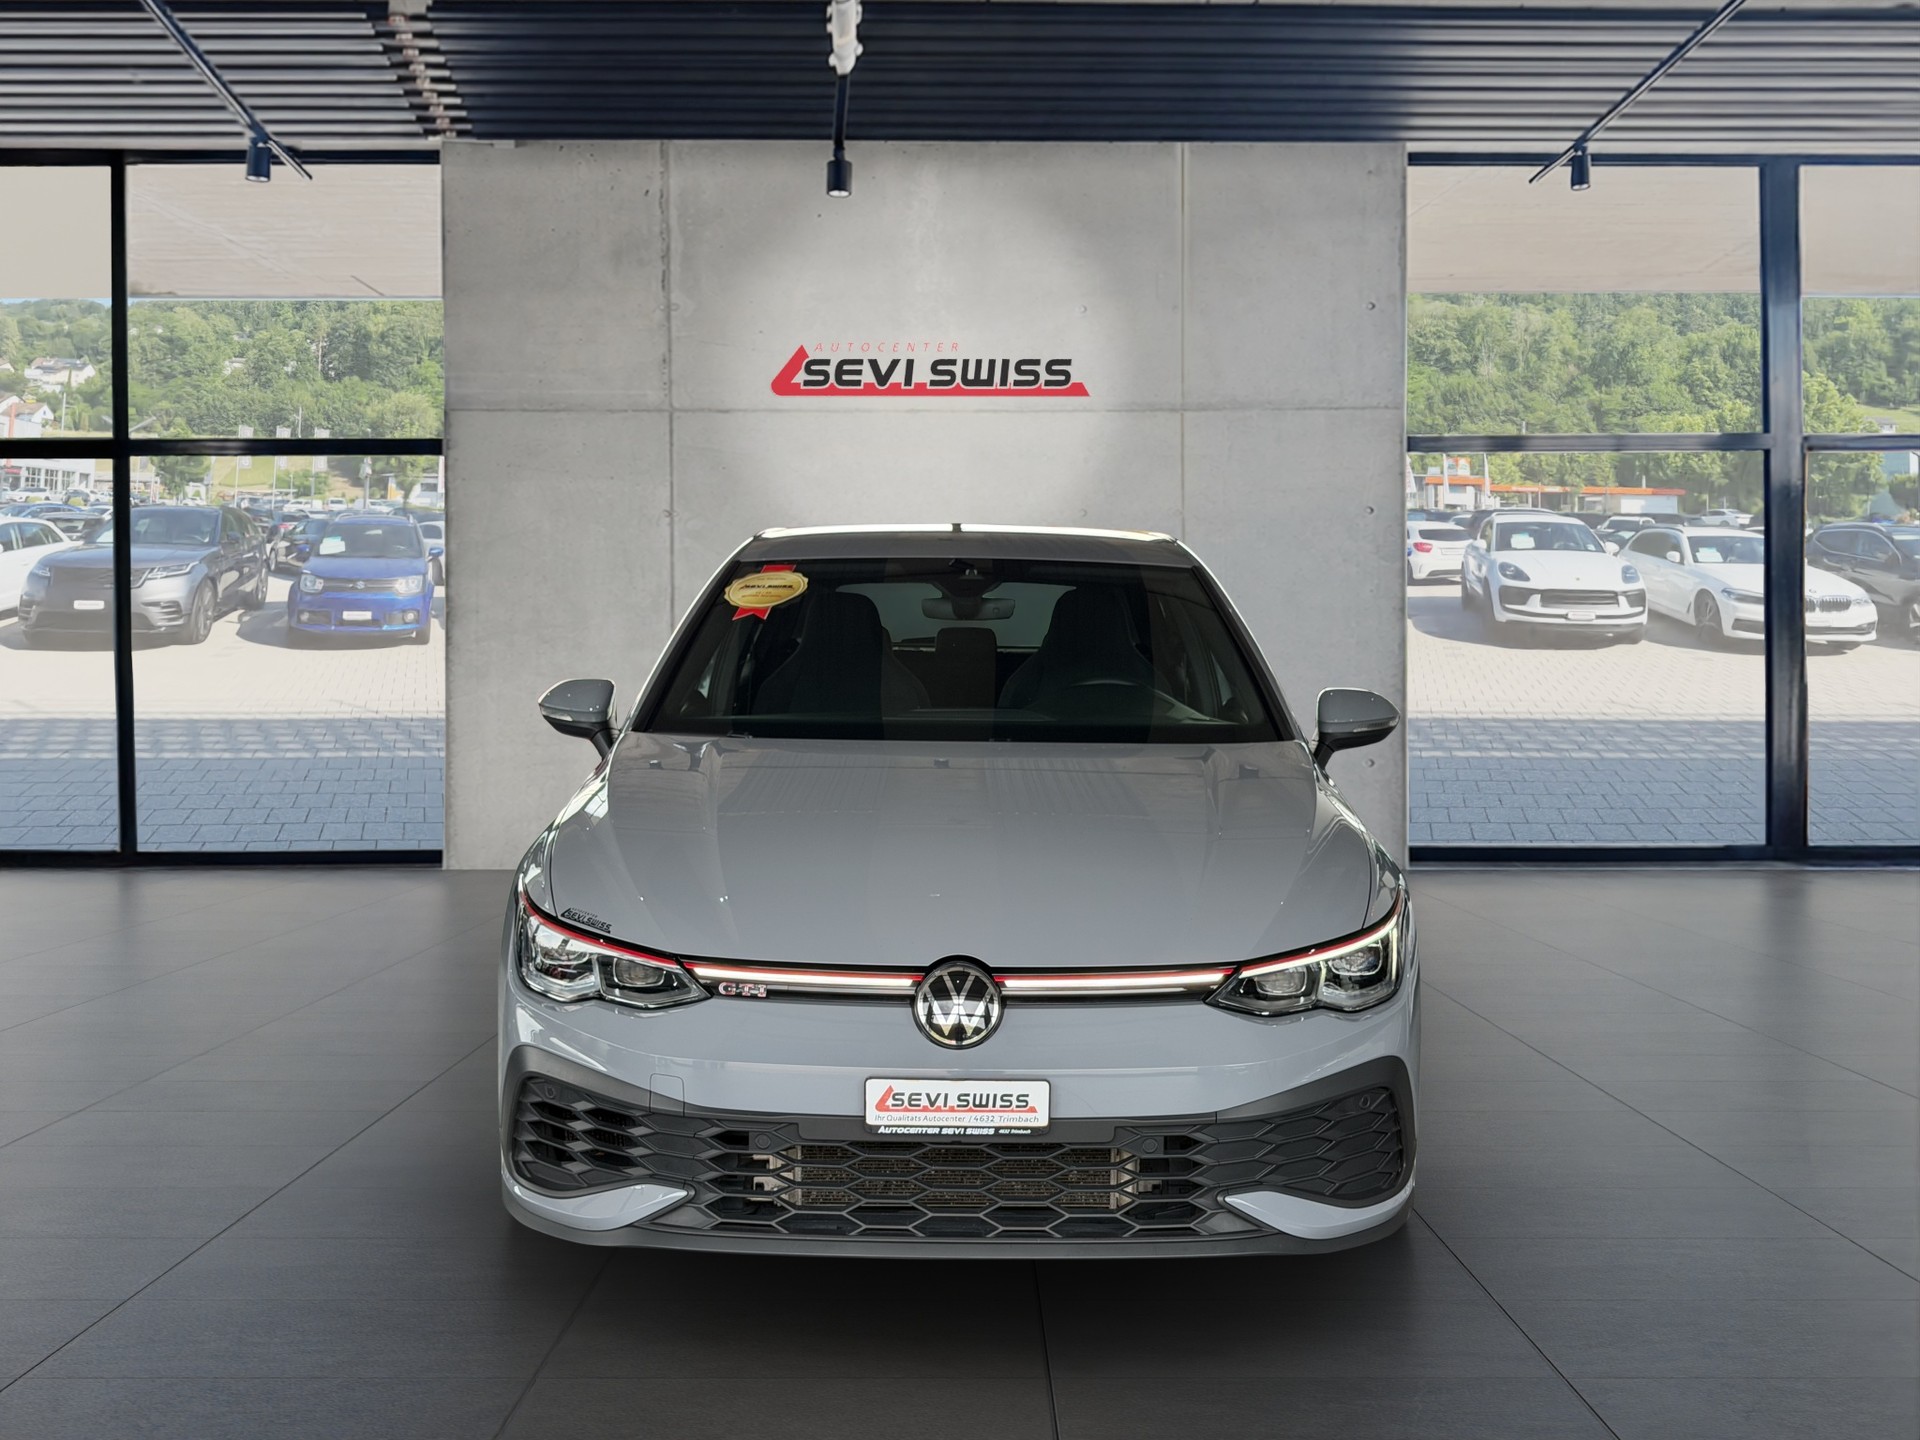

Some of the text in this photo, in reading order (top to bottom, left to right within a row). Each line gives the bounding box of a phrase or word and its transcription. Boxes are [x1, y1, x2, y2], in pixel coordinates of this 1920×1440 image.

[813, 342, 960, 353] AUTOCENTER
[802, 358, 1073, 388] SEVI SWISS
[564, 910, 613, 931] SEVI SWISS
[718, 981, 768, 998] GTI
[891, 1092, 1030, 1109] SEVI SWISS
[874, 1114, 886, 1122] Ihr
[923, 1115, 966, 1123] Autocenter
[973, 1115, 996, 1123] 4632
[998, 1115, 1040, 1123] Trimbach
[940, 1126, 965, 1135] SEVI
[965, 1127, 996, 1135] SWISS
